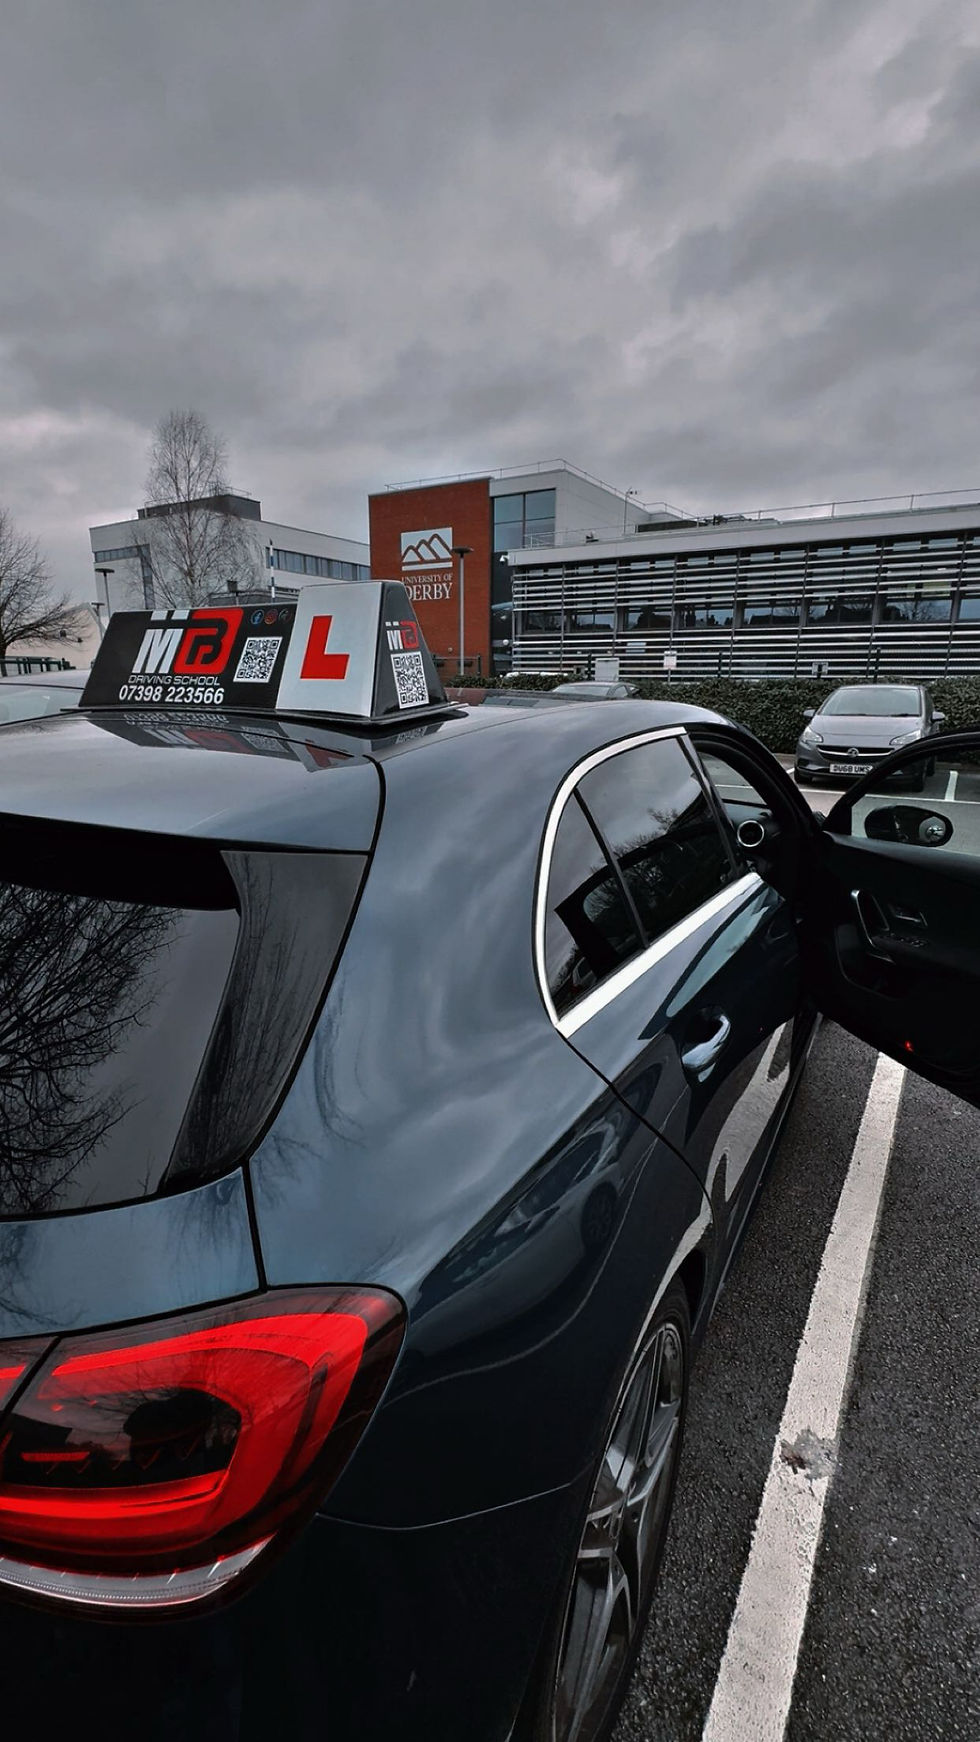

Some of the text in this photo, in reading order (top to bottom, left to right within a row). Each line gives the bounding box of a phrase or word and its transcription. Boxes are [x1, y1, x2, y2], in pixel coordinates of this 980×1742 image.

[402, 573, 453, 584] UNIVERSITY OF
[300, 615, 350, 680] L
[128, 675, 220, 686] DRIVING SCHOOL
[118, 685, 225, 704] 07398 223566
